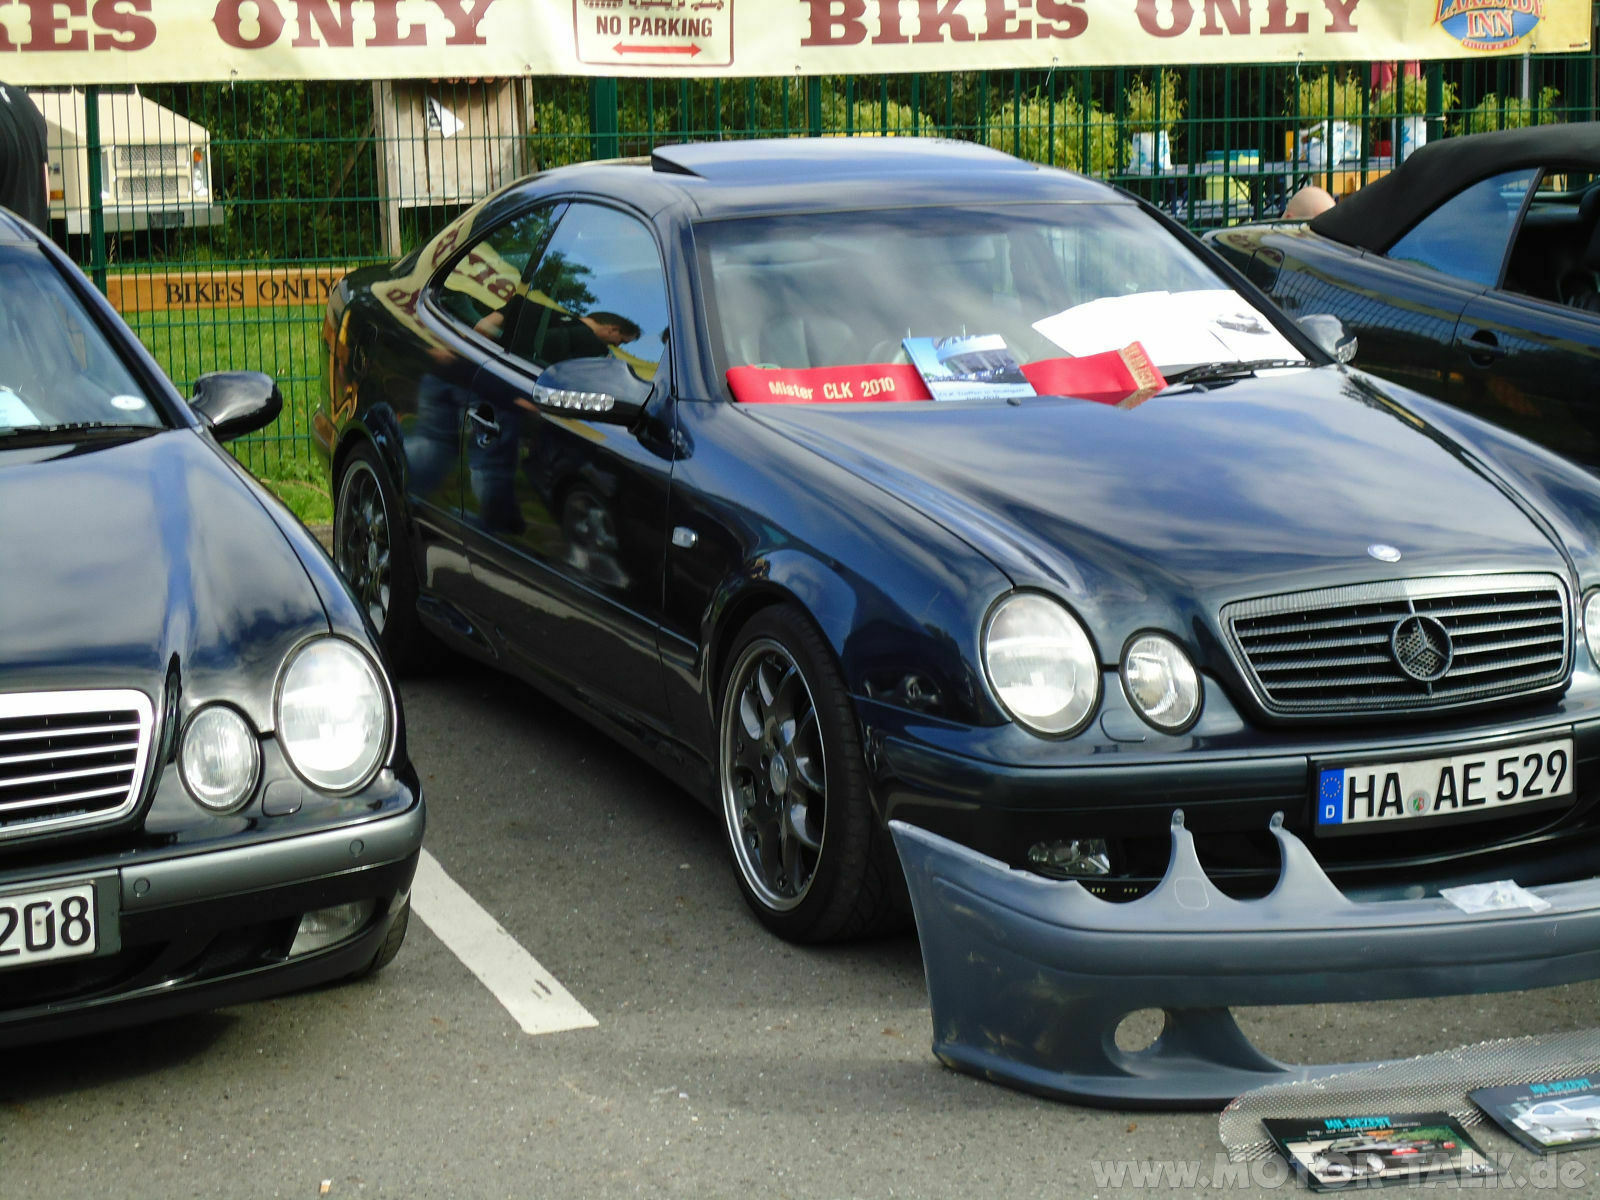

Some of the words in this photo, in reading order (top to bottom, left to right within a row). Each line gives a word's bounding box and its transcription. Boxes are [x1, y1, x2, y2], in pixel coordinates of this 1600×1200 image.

[211, 0, 494, 50] ONLY
[596, 15, 622, 36] NO
[628, 16, 713, 38] PARKING
[800, 0, 1089, 47] BIKES
[1134, 0, 1361, 38] ONLY
[1466, 9, 1514, 38] INN
[165, 281, 244, 304] BIKES
[258, 278, 338, 301] ONLY
[768, 381, 814, 400] Mister
[822, 382, 854, 400] CLK
[860, 376, 896, 398] 2010
[1348, 772, 1404, 819] HA
[1433, 761, 1486, 811] AE
[1497, 749, 1568, 801] 529
[1325, 804, 1335, 819] D
[0, 895, 91, 957] 208
